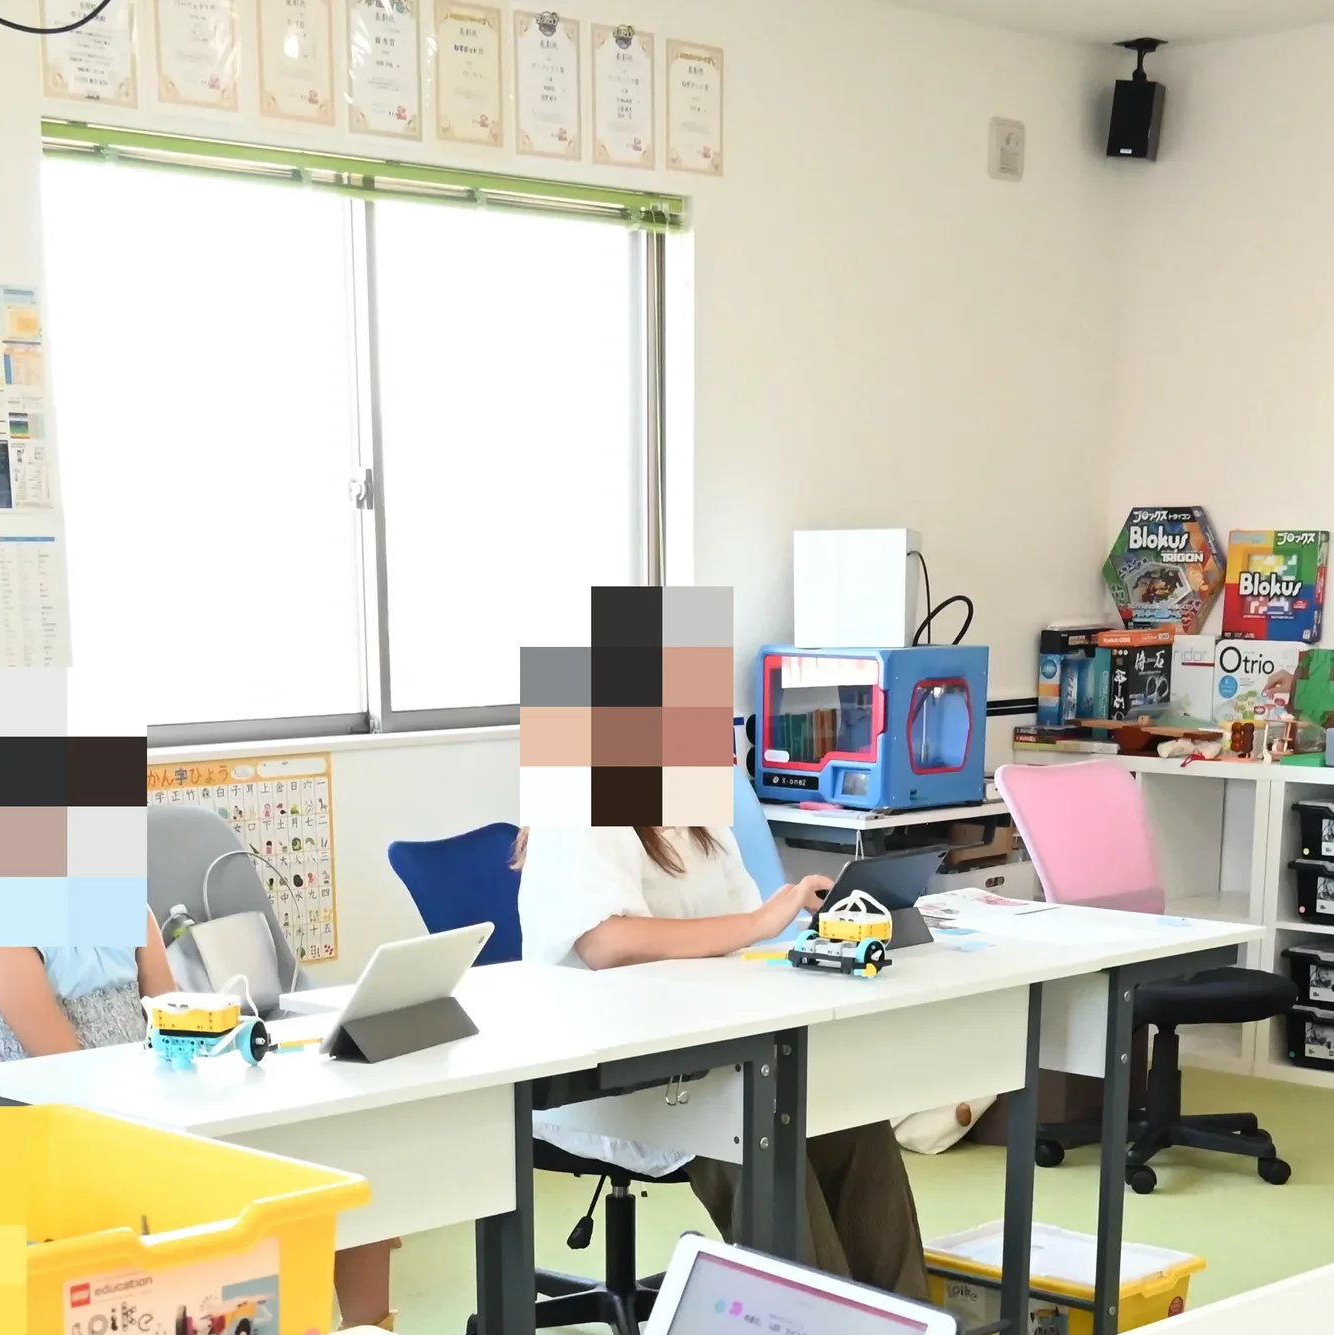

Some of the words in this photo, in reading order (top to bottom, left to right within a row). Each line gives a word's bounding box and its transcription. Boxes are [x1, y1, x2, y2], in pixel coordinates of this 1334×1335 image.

[1129, 525, 1189, 551] Blokus
[1277, 532, 1316, 545] ブロックス
[1160, 549, 1204, 563] TRIGON
[1239, 572, 1303, 599] Blokus
[1173, 646, 1208, 661] ridor
[1220, 646, 1275, 675] Otrio
[147, 765, 229, 788] かん字ひょう
[216, 787, 225, 798] 白
[230, 785, 241, 797] 子
[94, 1276, 153, 1297] education
